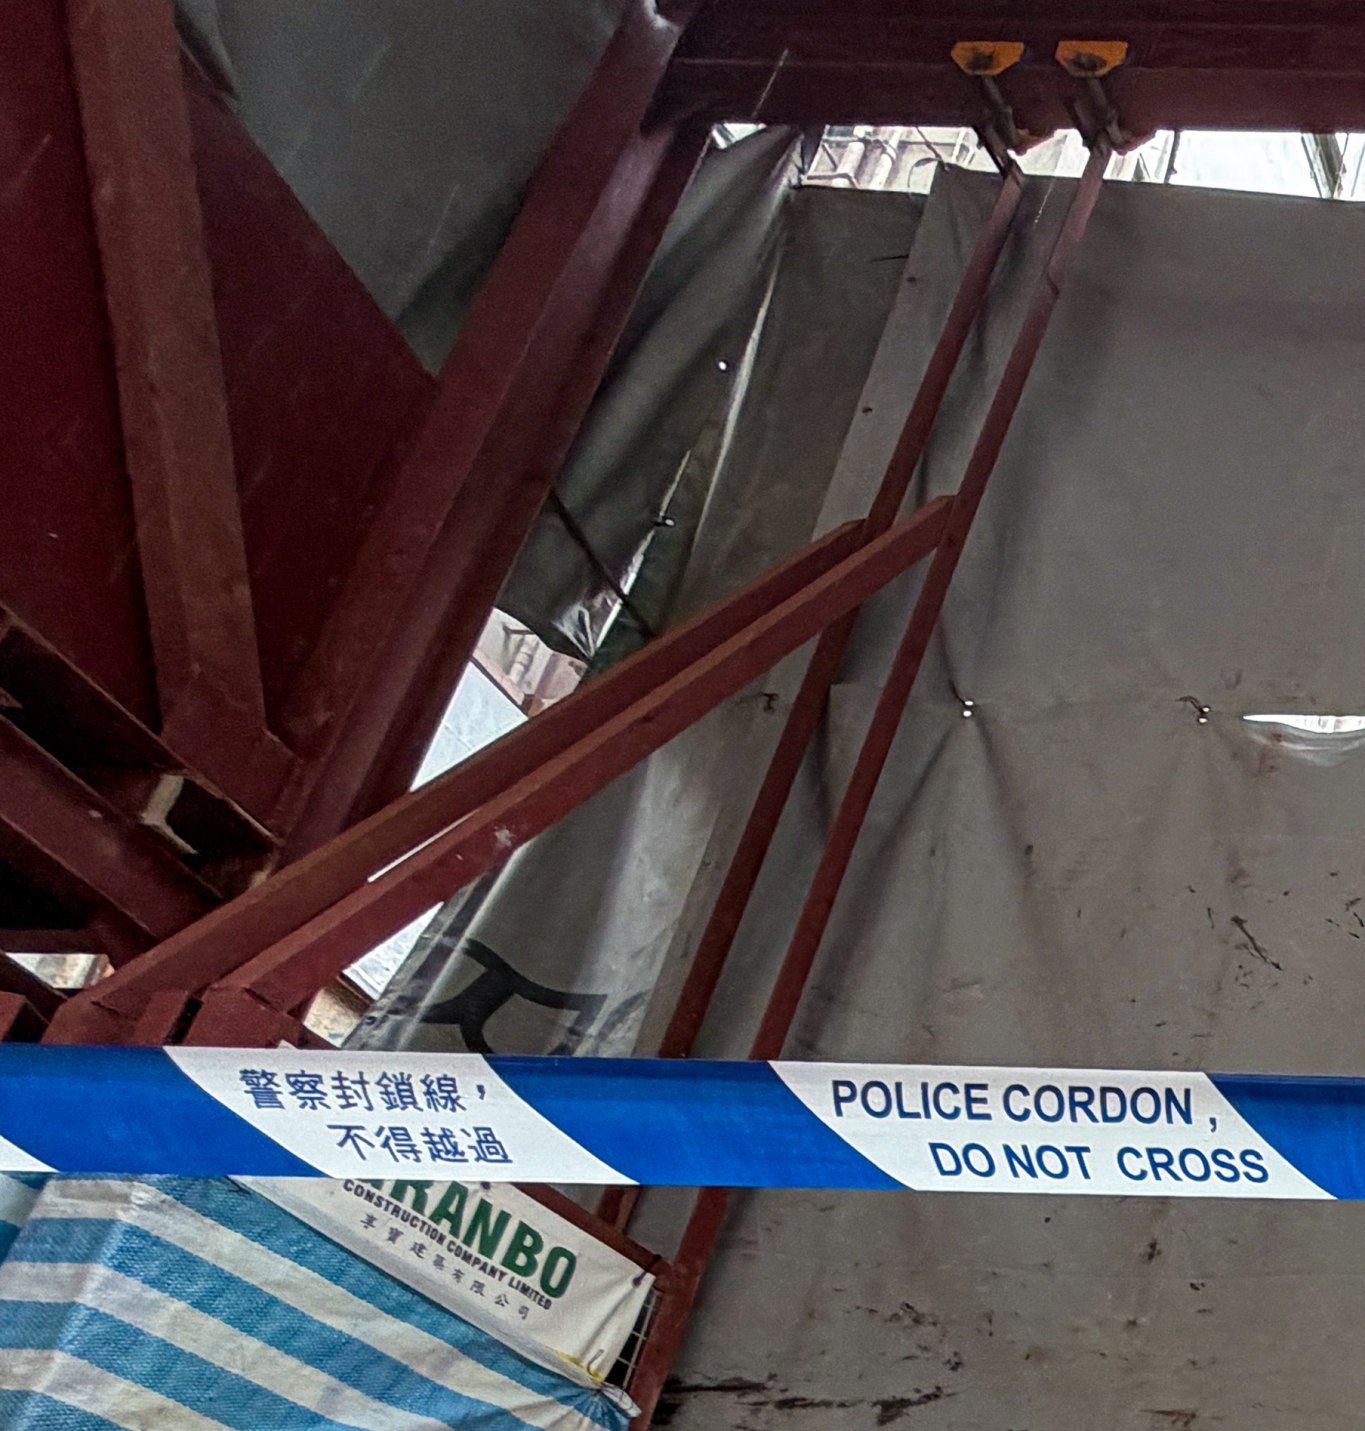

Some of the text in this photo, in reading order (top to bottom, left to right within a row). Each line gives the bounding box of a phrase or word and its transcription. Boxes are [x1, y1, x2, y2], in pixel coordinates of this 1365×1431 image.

[832, 1079, 991, 1120] POLICE
[328, 1124, 512, 1164] 不得越過
[928, 1143, 1269, 1183] DO NOT CROSS
[343, 1179, 552, 1310] CONSTRUCTION COMPANY LIMITED
[355, 1179, 576, 1298] RANBO
